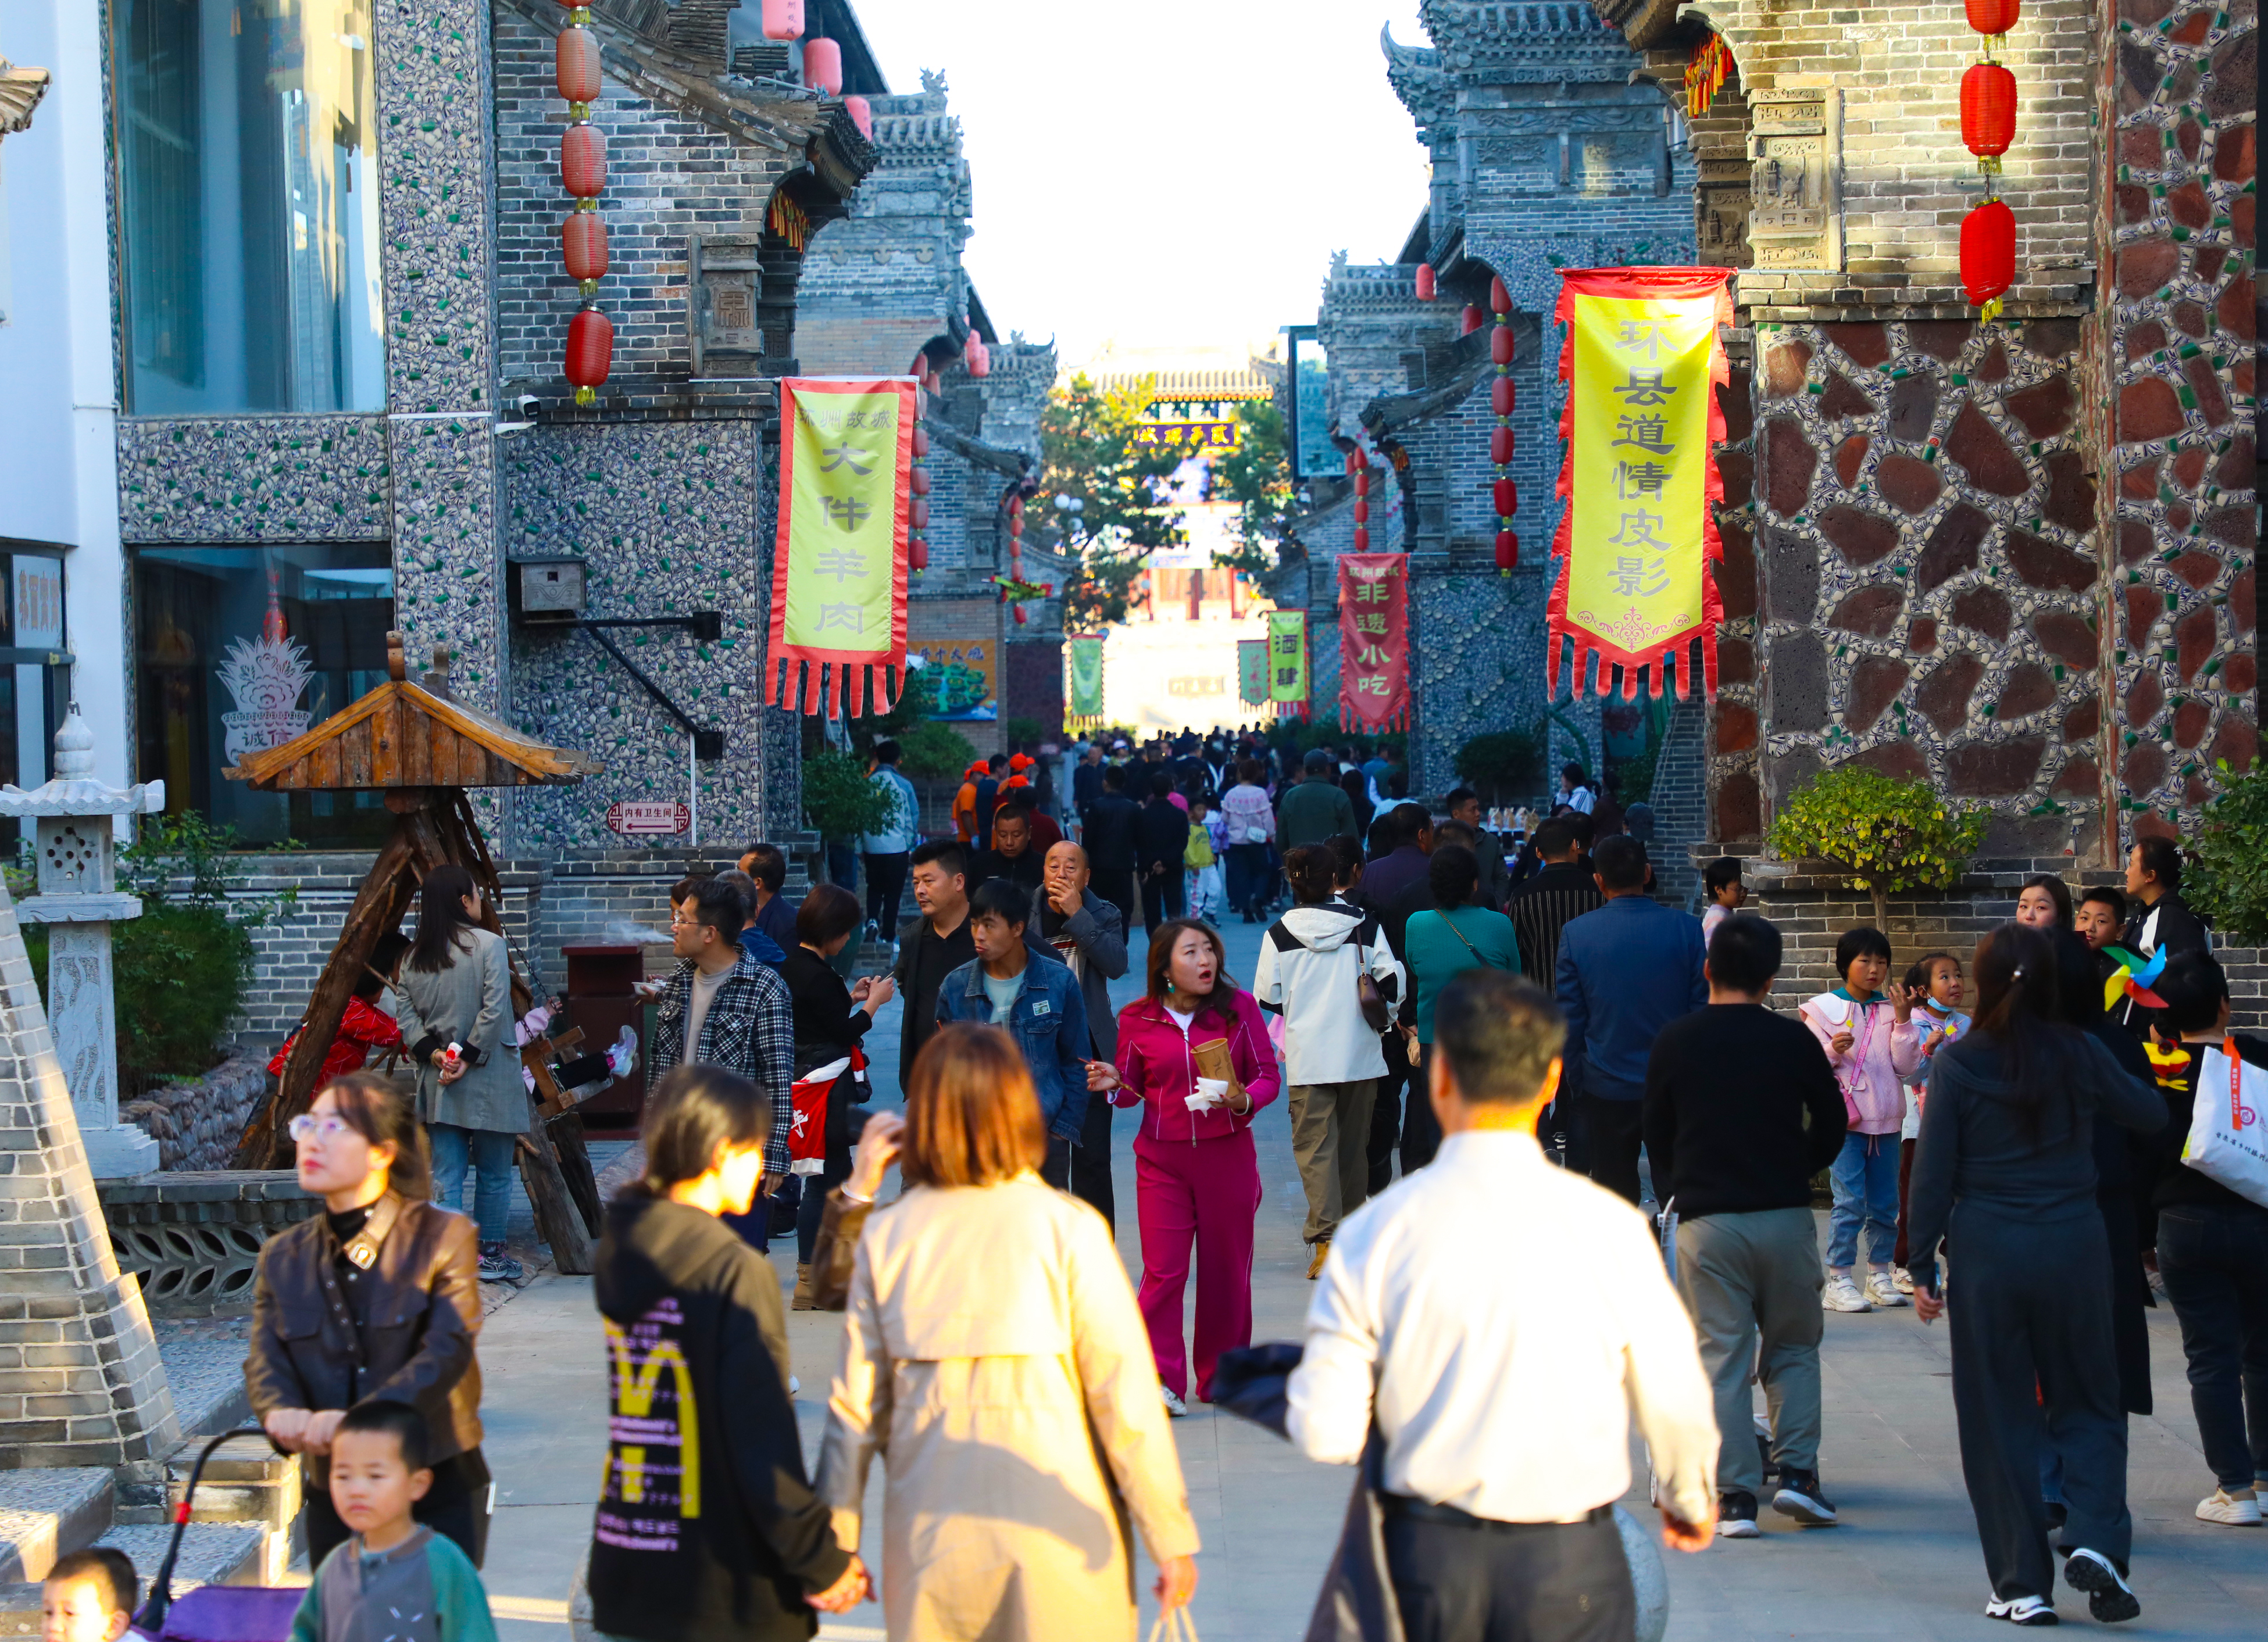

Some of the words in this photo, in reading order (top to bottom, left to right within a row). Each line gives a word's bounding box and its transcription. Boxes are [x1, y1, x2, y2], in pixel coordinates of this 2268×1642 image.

[799, 407, 892, 430] 环州故城
[1606, 320, 1678, 598] 环县道情皮影
[813, 441, 873, 635] 大件羊肉
[1275, 634, 1298, 687] 酒肆
[1356, 582, 1391, 696] 非遗小吃
[242, 729, 292, 746] 诚信
[625, 808, 672, 818] 内有卫生间
